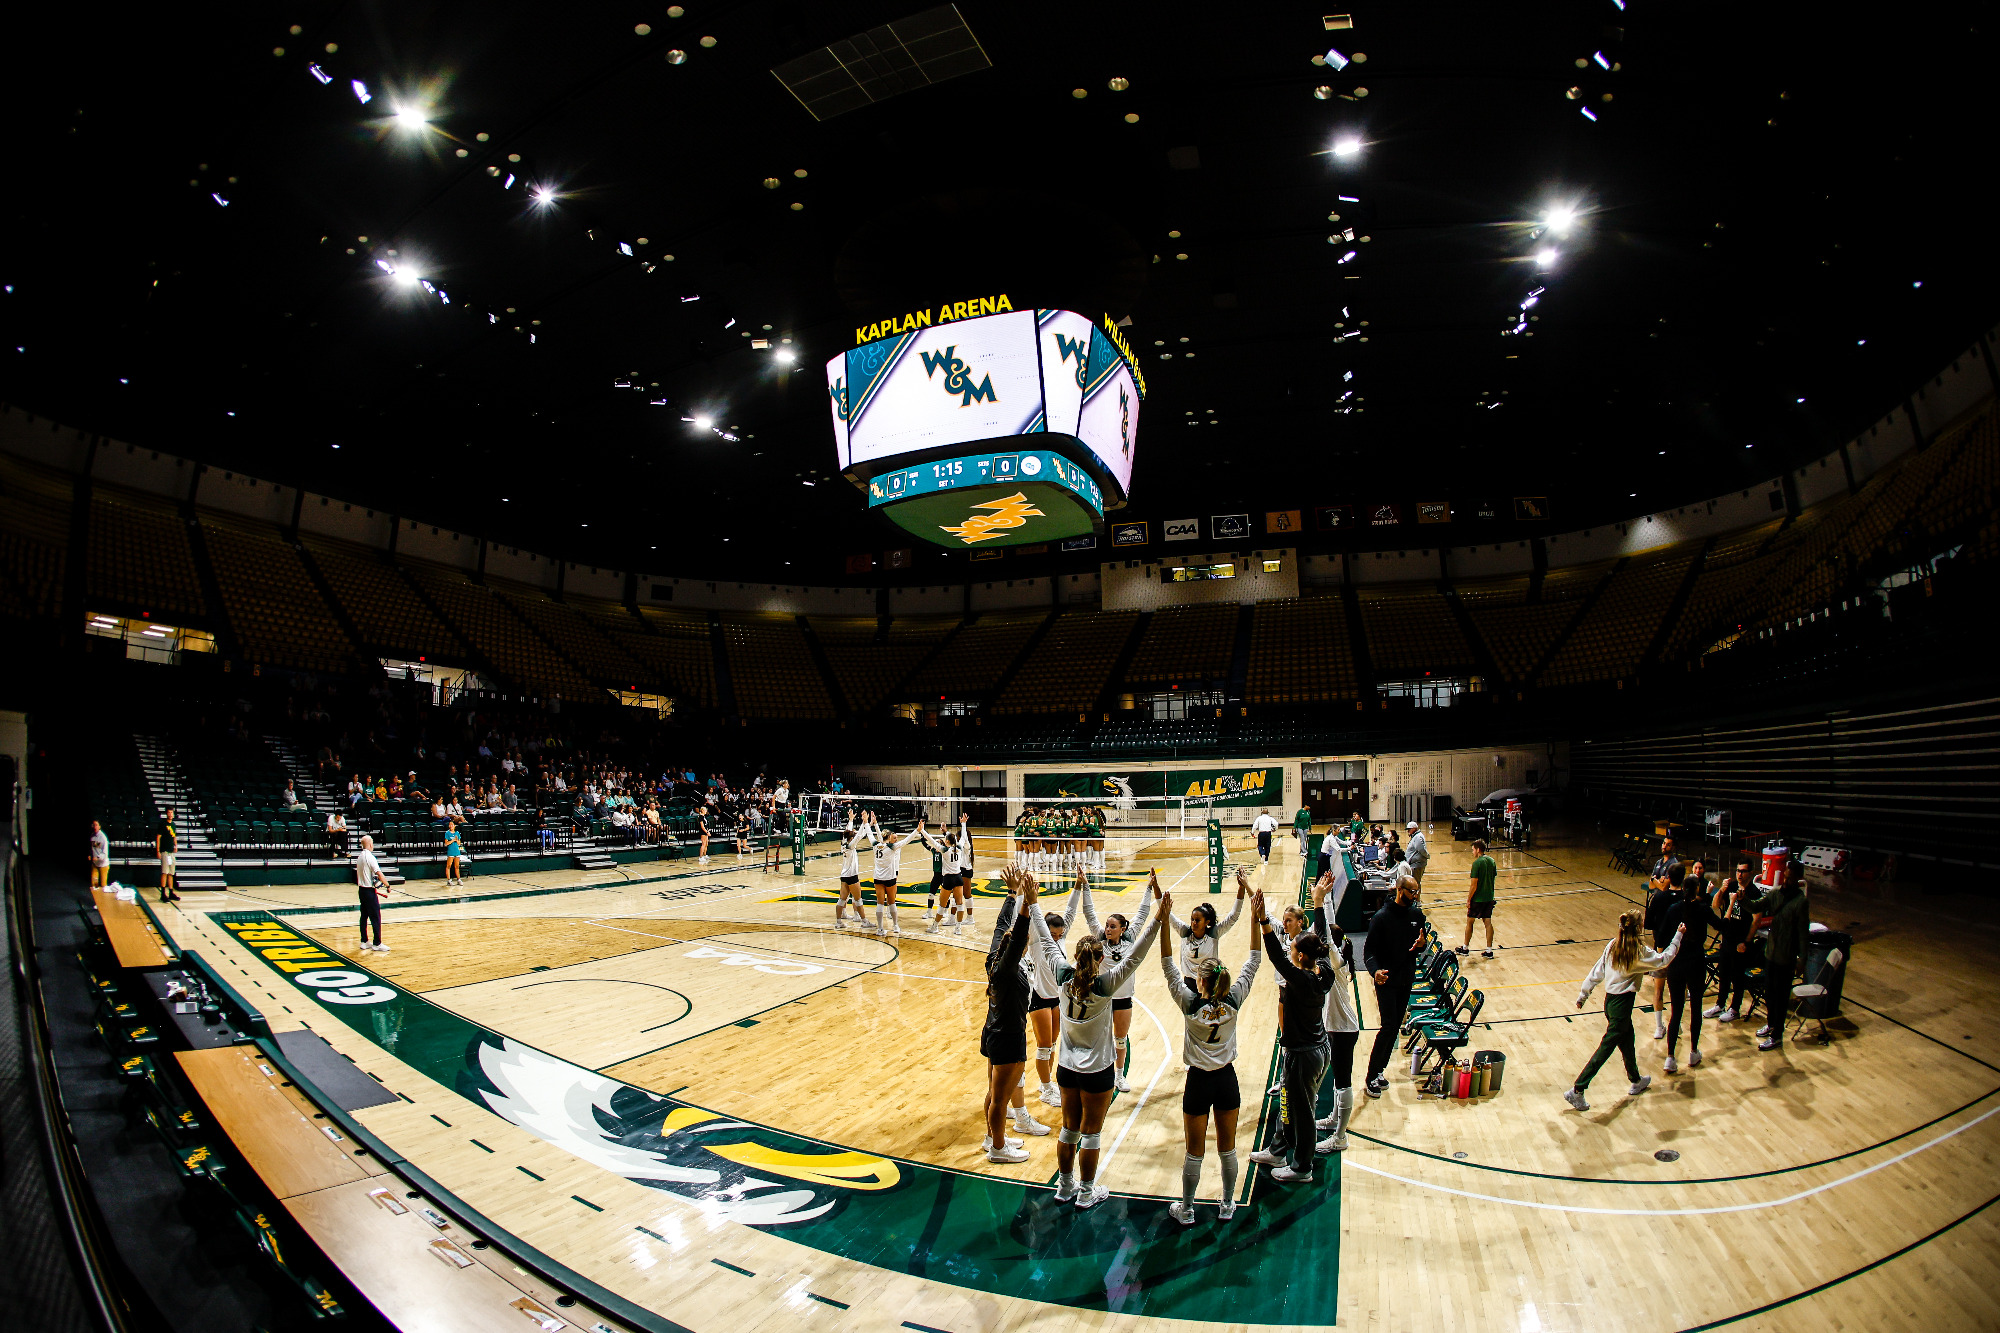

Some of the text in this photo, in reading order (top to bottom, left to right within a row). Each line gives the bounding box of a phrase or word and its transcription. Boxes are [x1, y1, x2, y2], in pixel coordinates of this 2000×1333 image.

[856, 293, 1013, 344] KAPLAN ARENA
[917, 344, 1001, 409] W&M
[933, 461, 963, 478] 1:15
[1001, 460, 1010, 472] 0
[893, 477, 900, 489] 0
[1166, 524, 1197, 535] CAA
[1185, 778, 1227, 797] ALL
[1242, 770, 1266, 790] IN
[876, 850, 883, 858] 15
[1209, 837, 1218, 884] TRIBE
[224, 922, 398, 1004] GO TRIBE
[682, 947, 826, 975] CAA
[1206, 1023, 1221, 1043] 2
